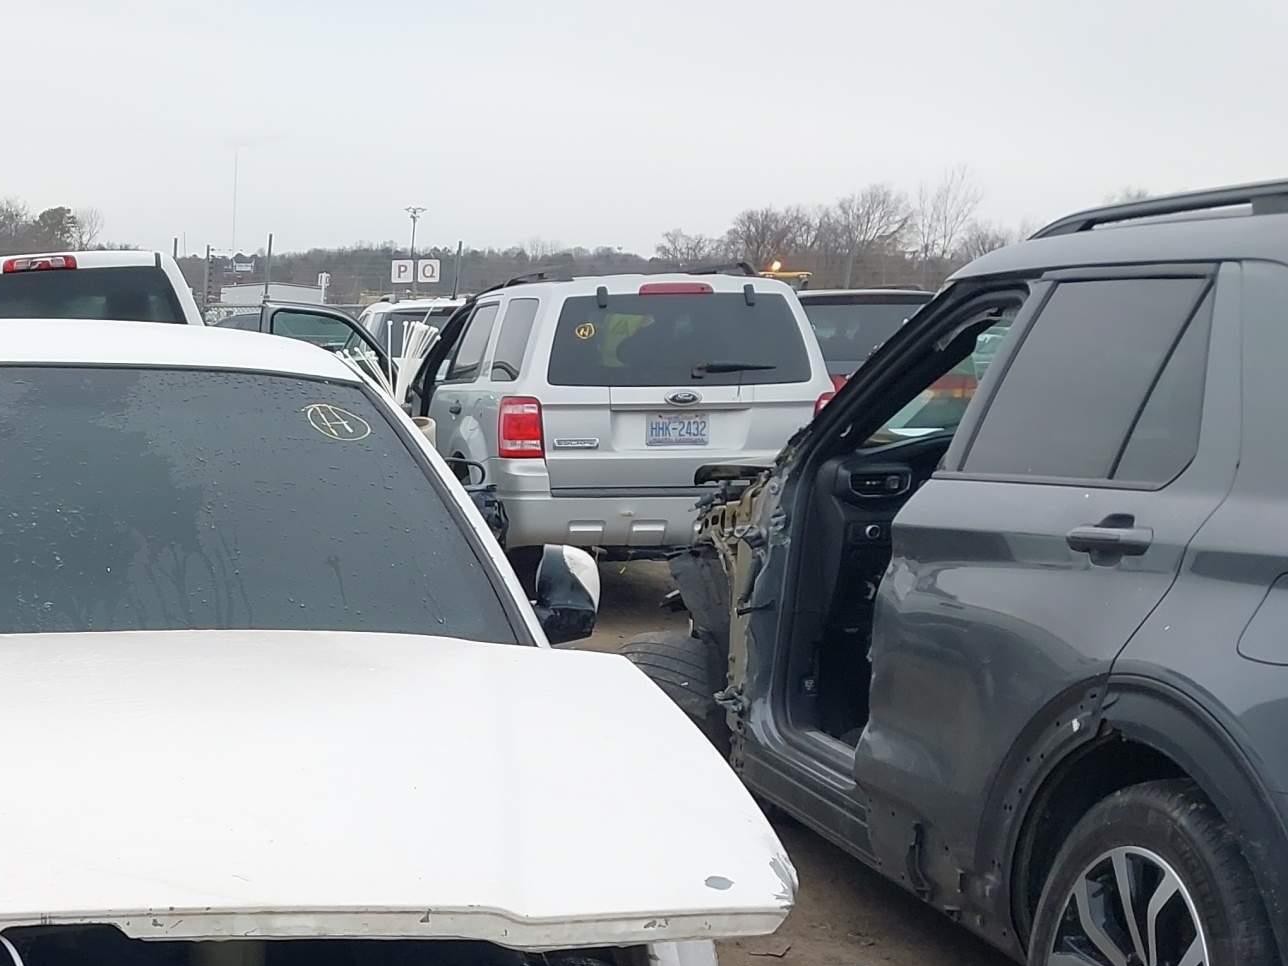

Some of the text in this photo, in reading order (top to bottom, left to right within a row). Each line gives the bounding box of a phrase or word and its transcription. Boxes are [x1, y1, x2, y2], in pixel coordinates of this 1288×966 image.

[397, 263, 436, 279] P Q
[650, 420, 707, 437] HHK-2432
